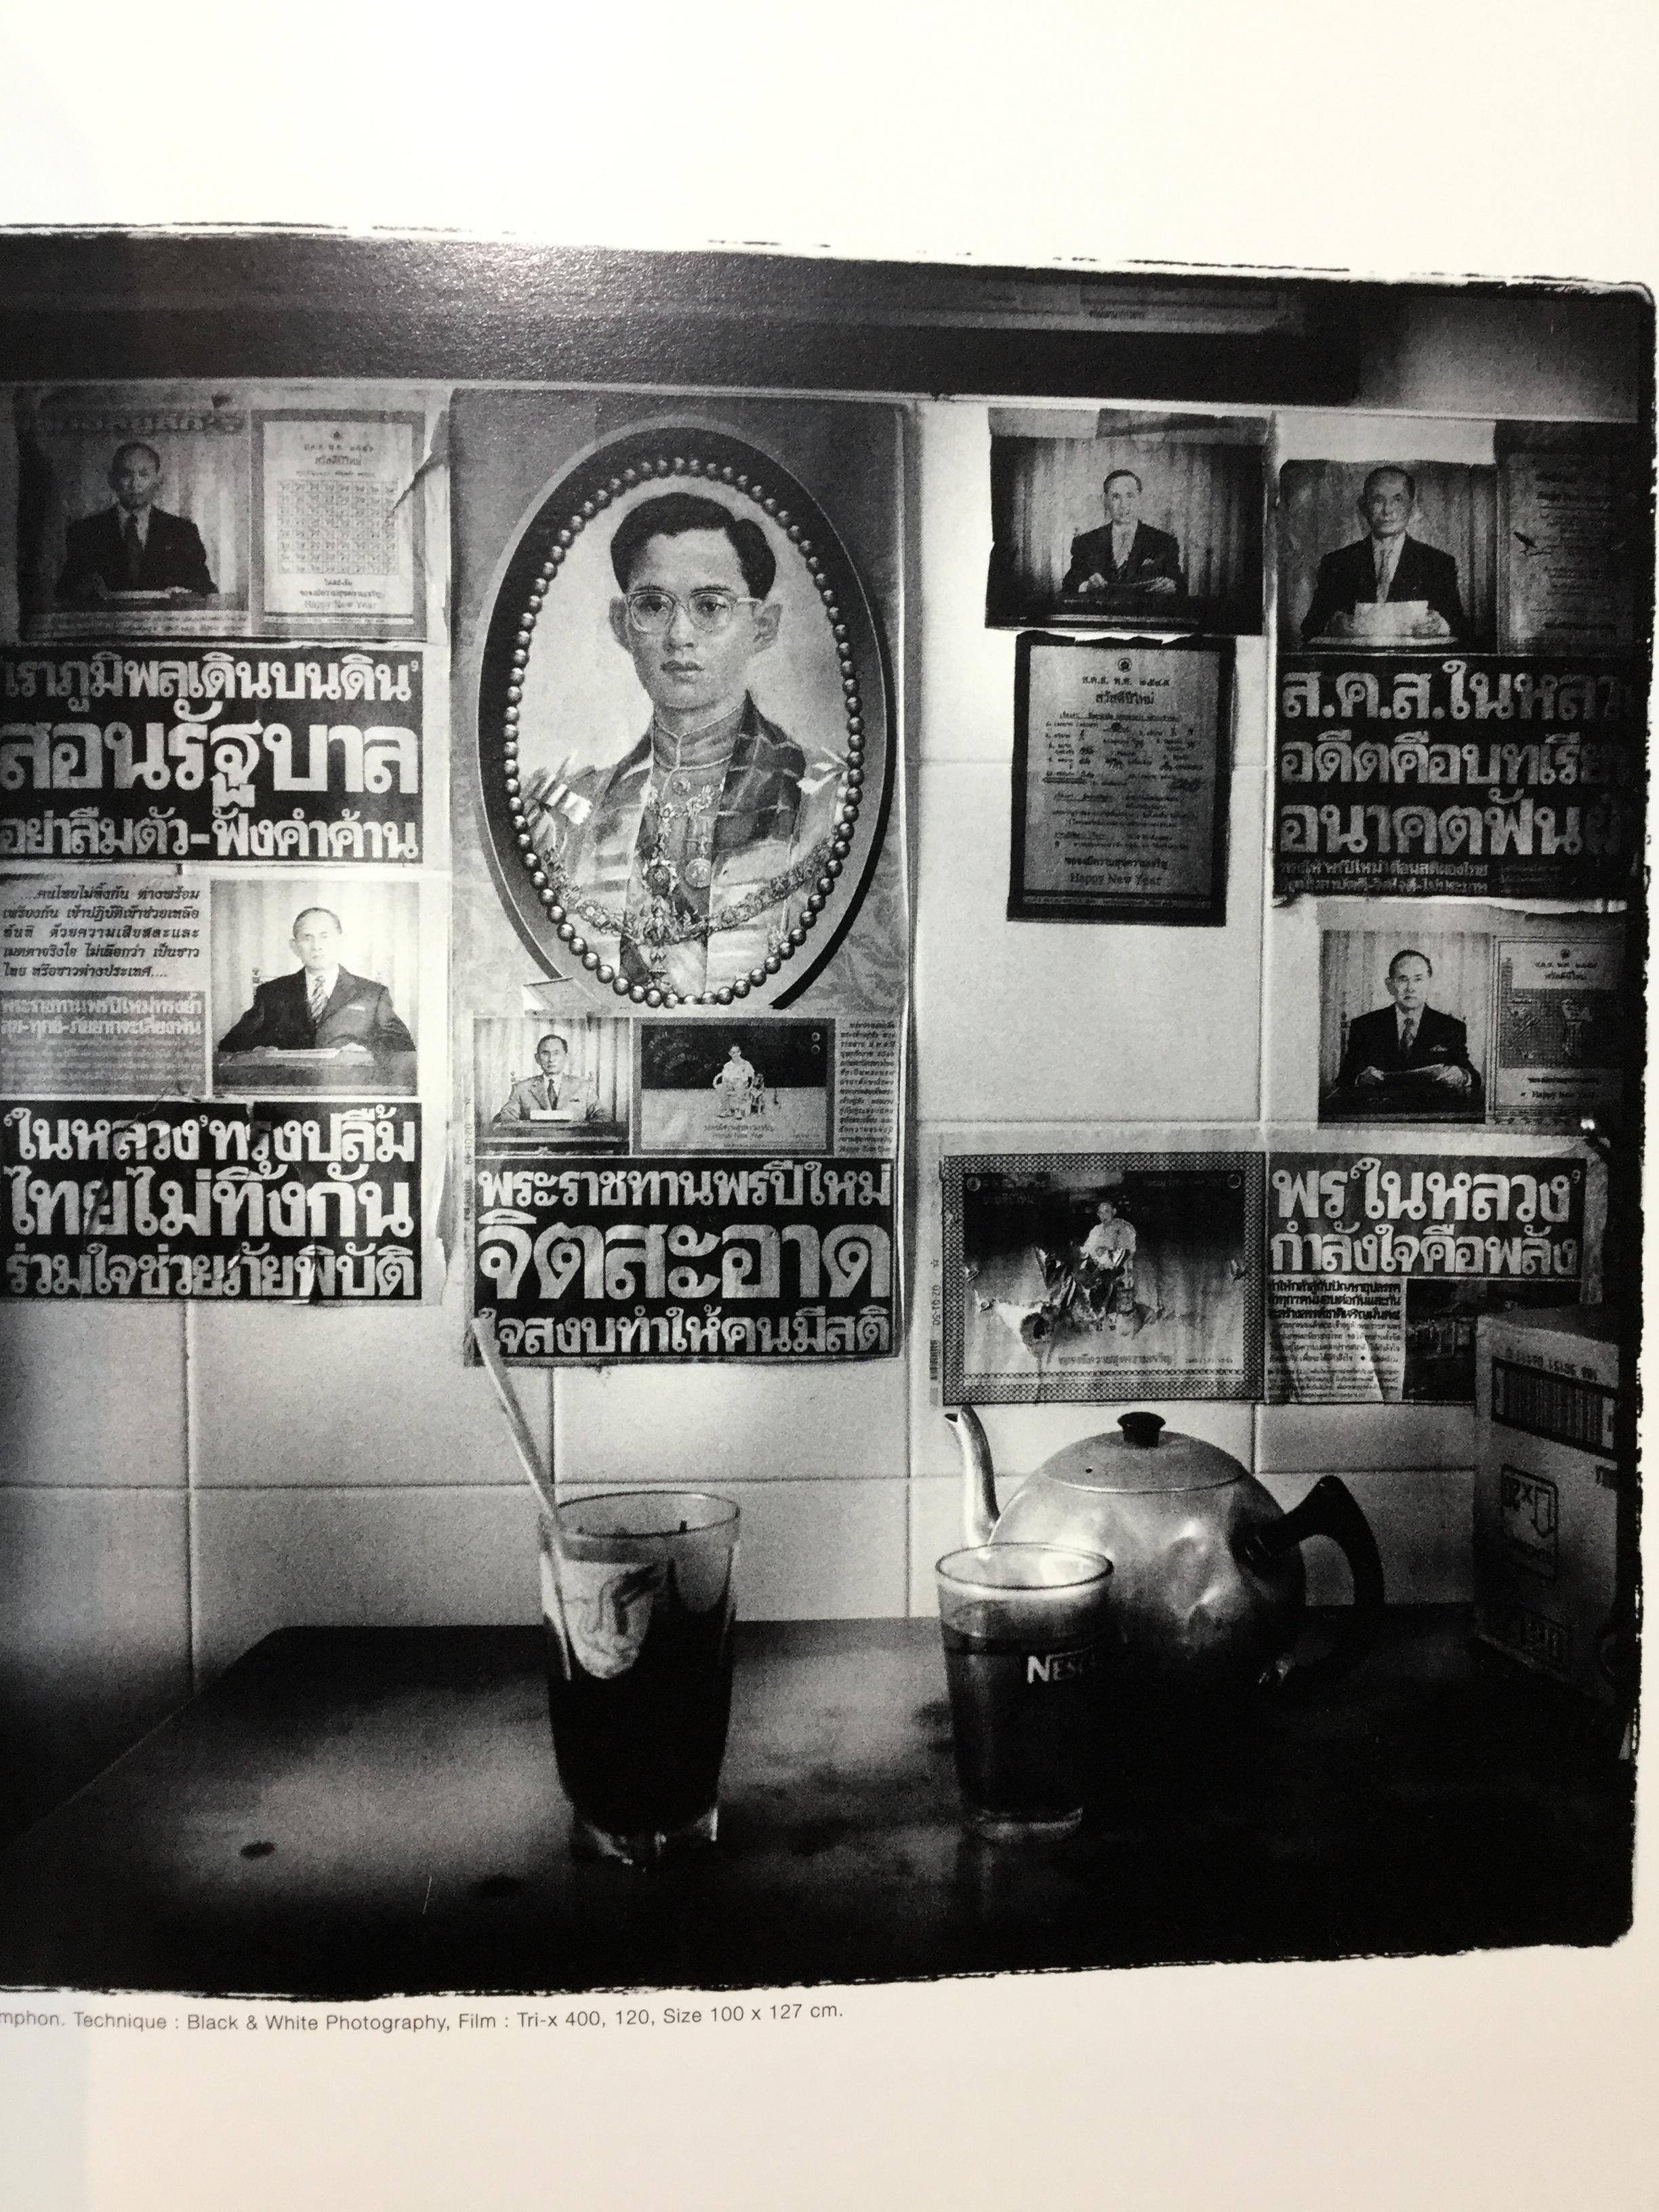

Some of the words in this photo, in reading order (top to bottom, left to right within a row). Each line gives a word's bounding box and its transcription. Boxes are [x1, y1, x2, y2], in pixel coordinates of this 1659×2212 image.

[0, 699, 418, 808] สอนรัฐบาล
[3, 1160, 415, 1237] ไทยไม่ทิ้งกัน
[477, 1160, 891, 1207] พระราชทานพรปีใหม่
[477, 1209, 891, 1300] จิตสะอาด
[1270, 1221, 1578, 1275] กำลังใจคือพลัง
[73, 2011, 167, 2030] Technique
[187, 2013, 239, 2030] Black
[245, 2014, 260, 2030] &
[265, 2014, 319, 2031] White
[325, 2015, 451, 2034] Photography,
[458, 2013, 497, 2029] Film
[516, 2011, 558, 2028] Tri-x
[565, 2011, 607, 2028] 400,
[615, 2009, 655, 2026] 120,
[662, 2007, 702, 2024] Size
[710, 2005, 745, 2022] 100
[750, 2008, 762, 2022] x
[769, 2003, 803, 2020] 127
[810, 2002, 844, 2019] cm.
